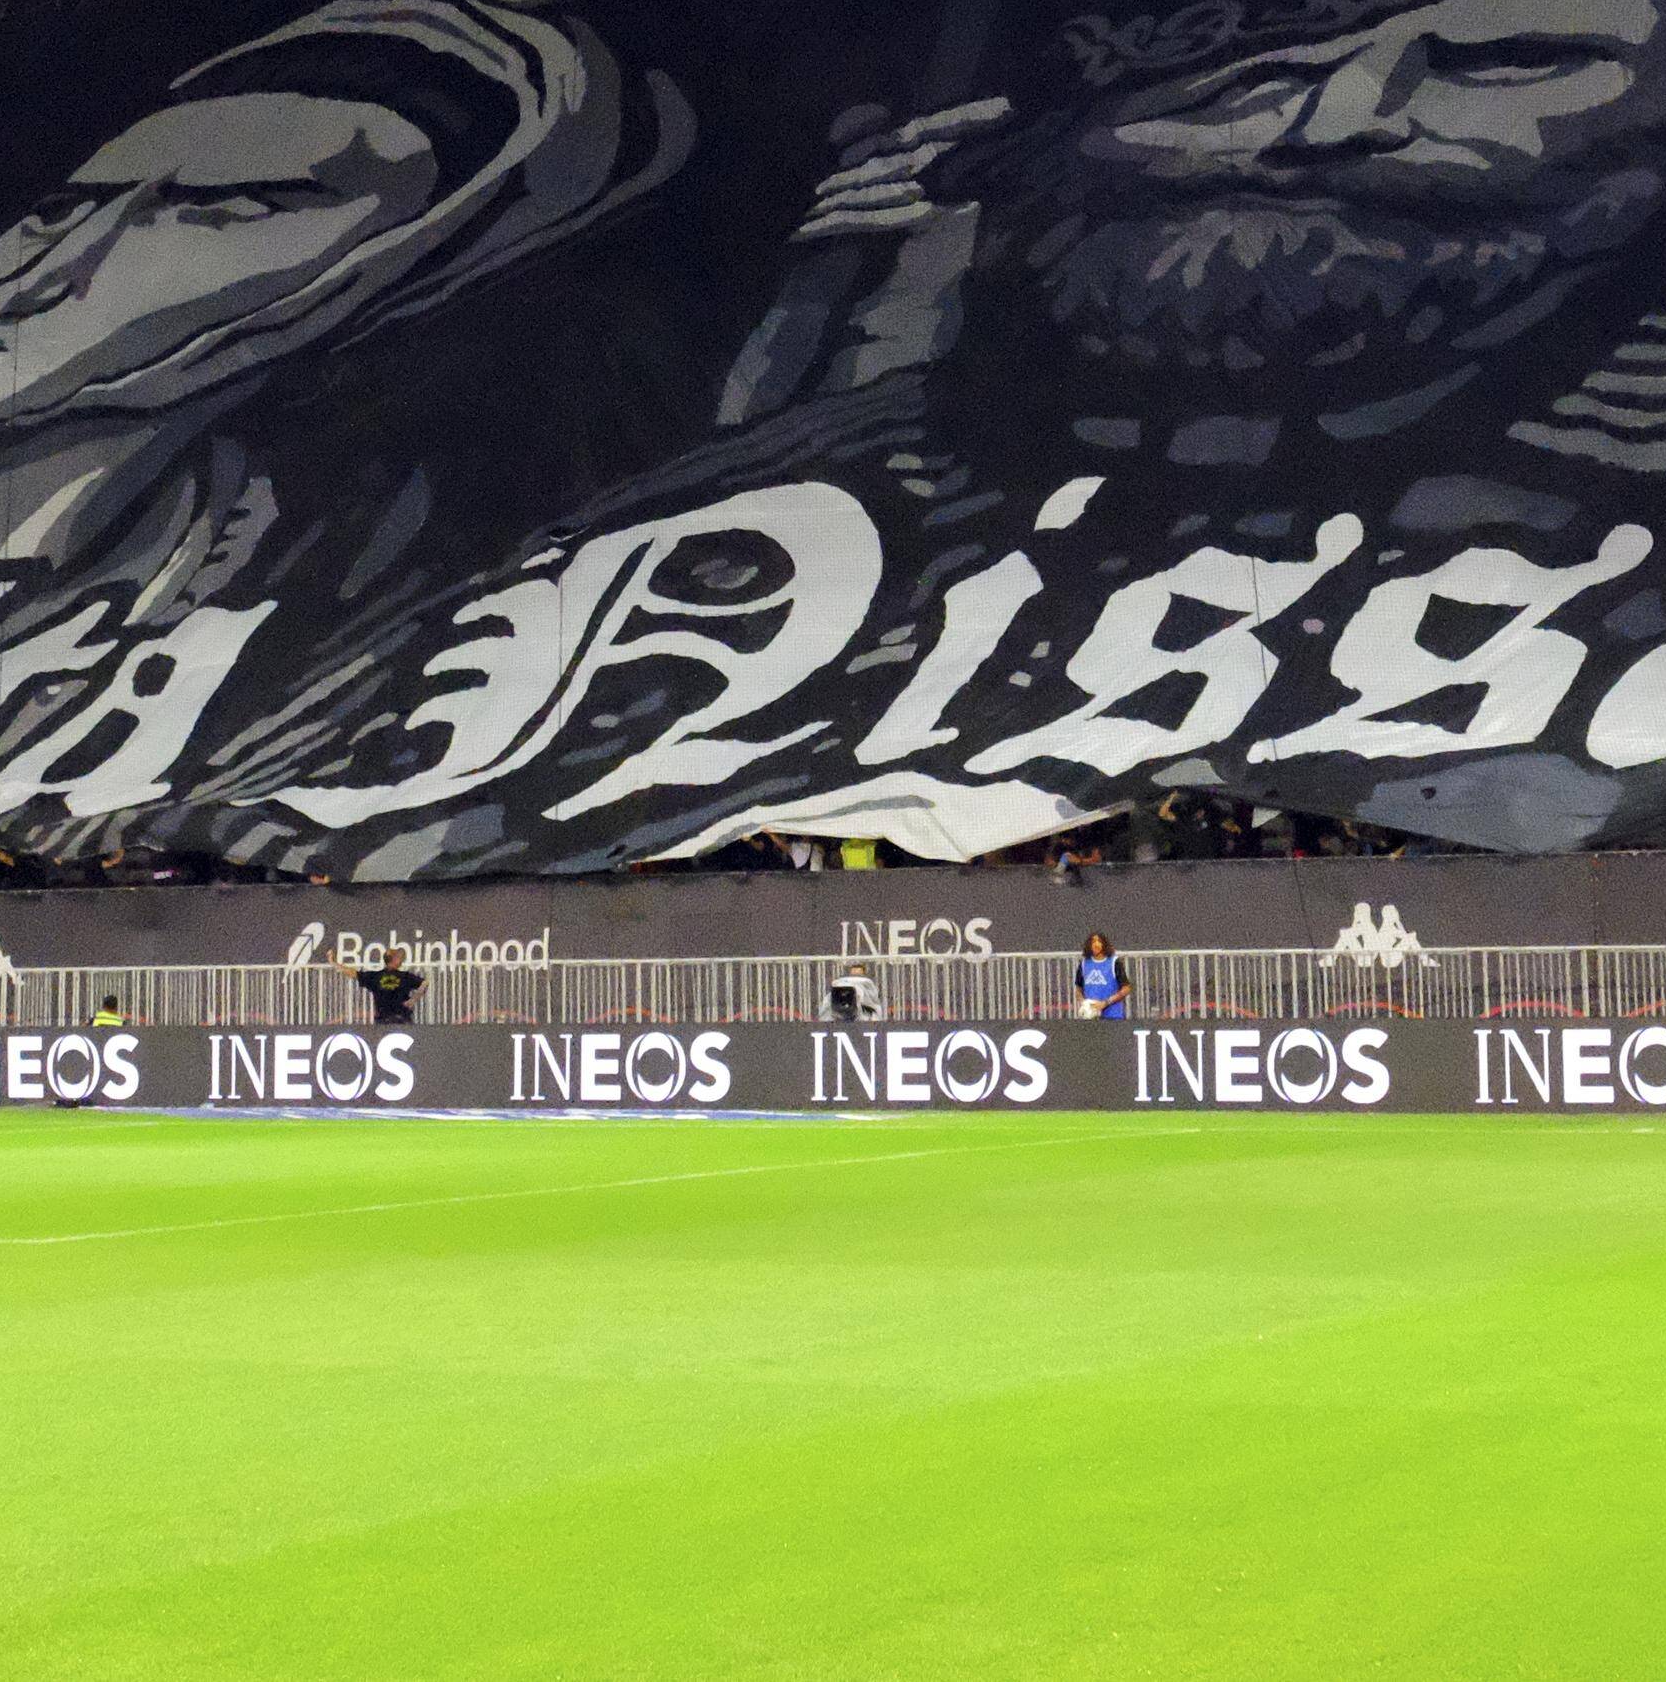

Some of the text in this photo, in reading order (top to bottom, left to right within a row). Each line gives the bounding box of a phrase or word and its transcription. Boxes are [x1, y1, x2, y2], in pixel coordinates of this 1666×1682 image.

[336, 926, 551, 971] Robinhood
[840, 917, 994, 965] INEOS
[208, 1033, 415, 1101] INEOS
[509, 1031, 732, 1102] INEOS
[810, 1029, 1049, 1103] INEOS
[1133, 1028, 1391, 1104] INEOS
